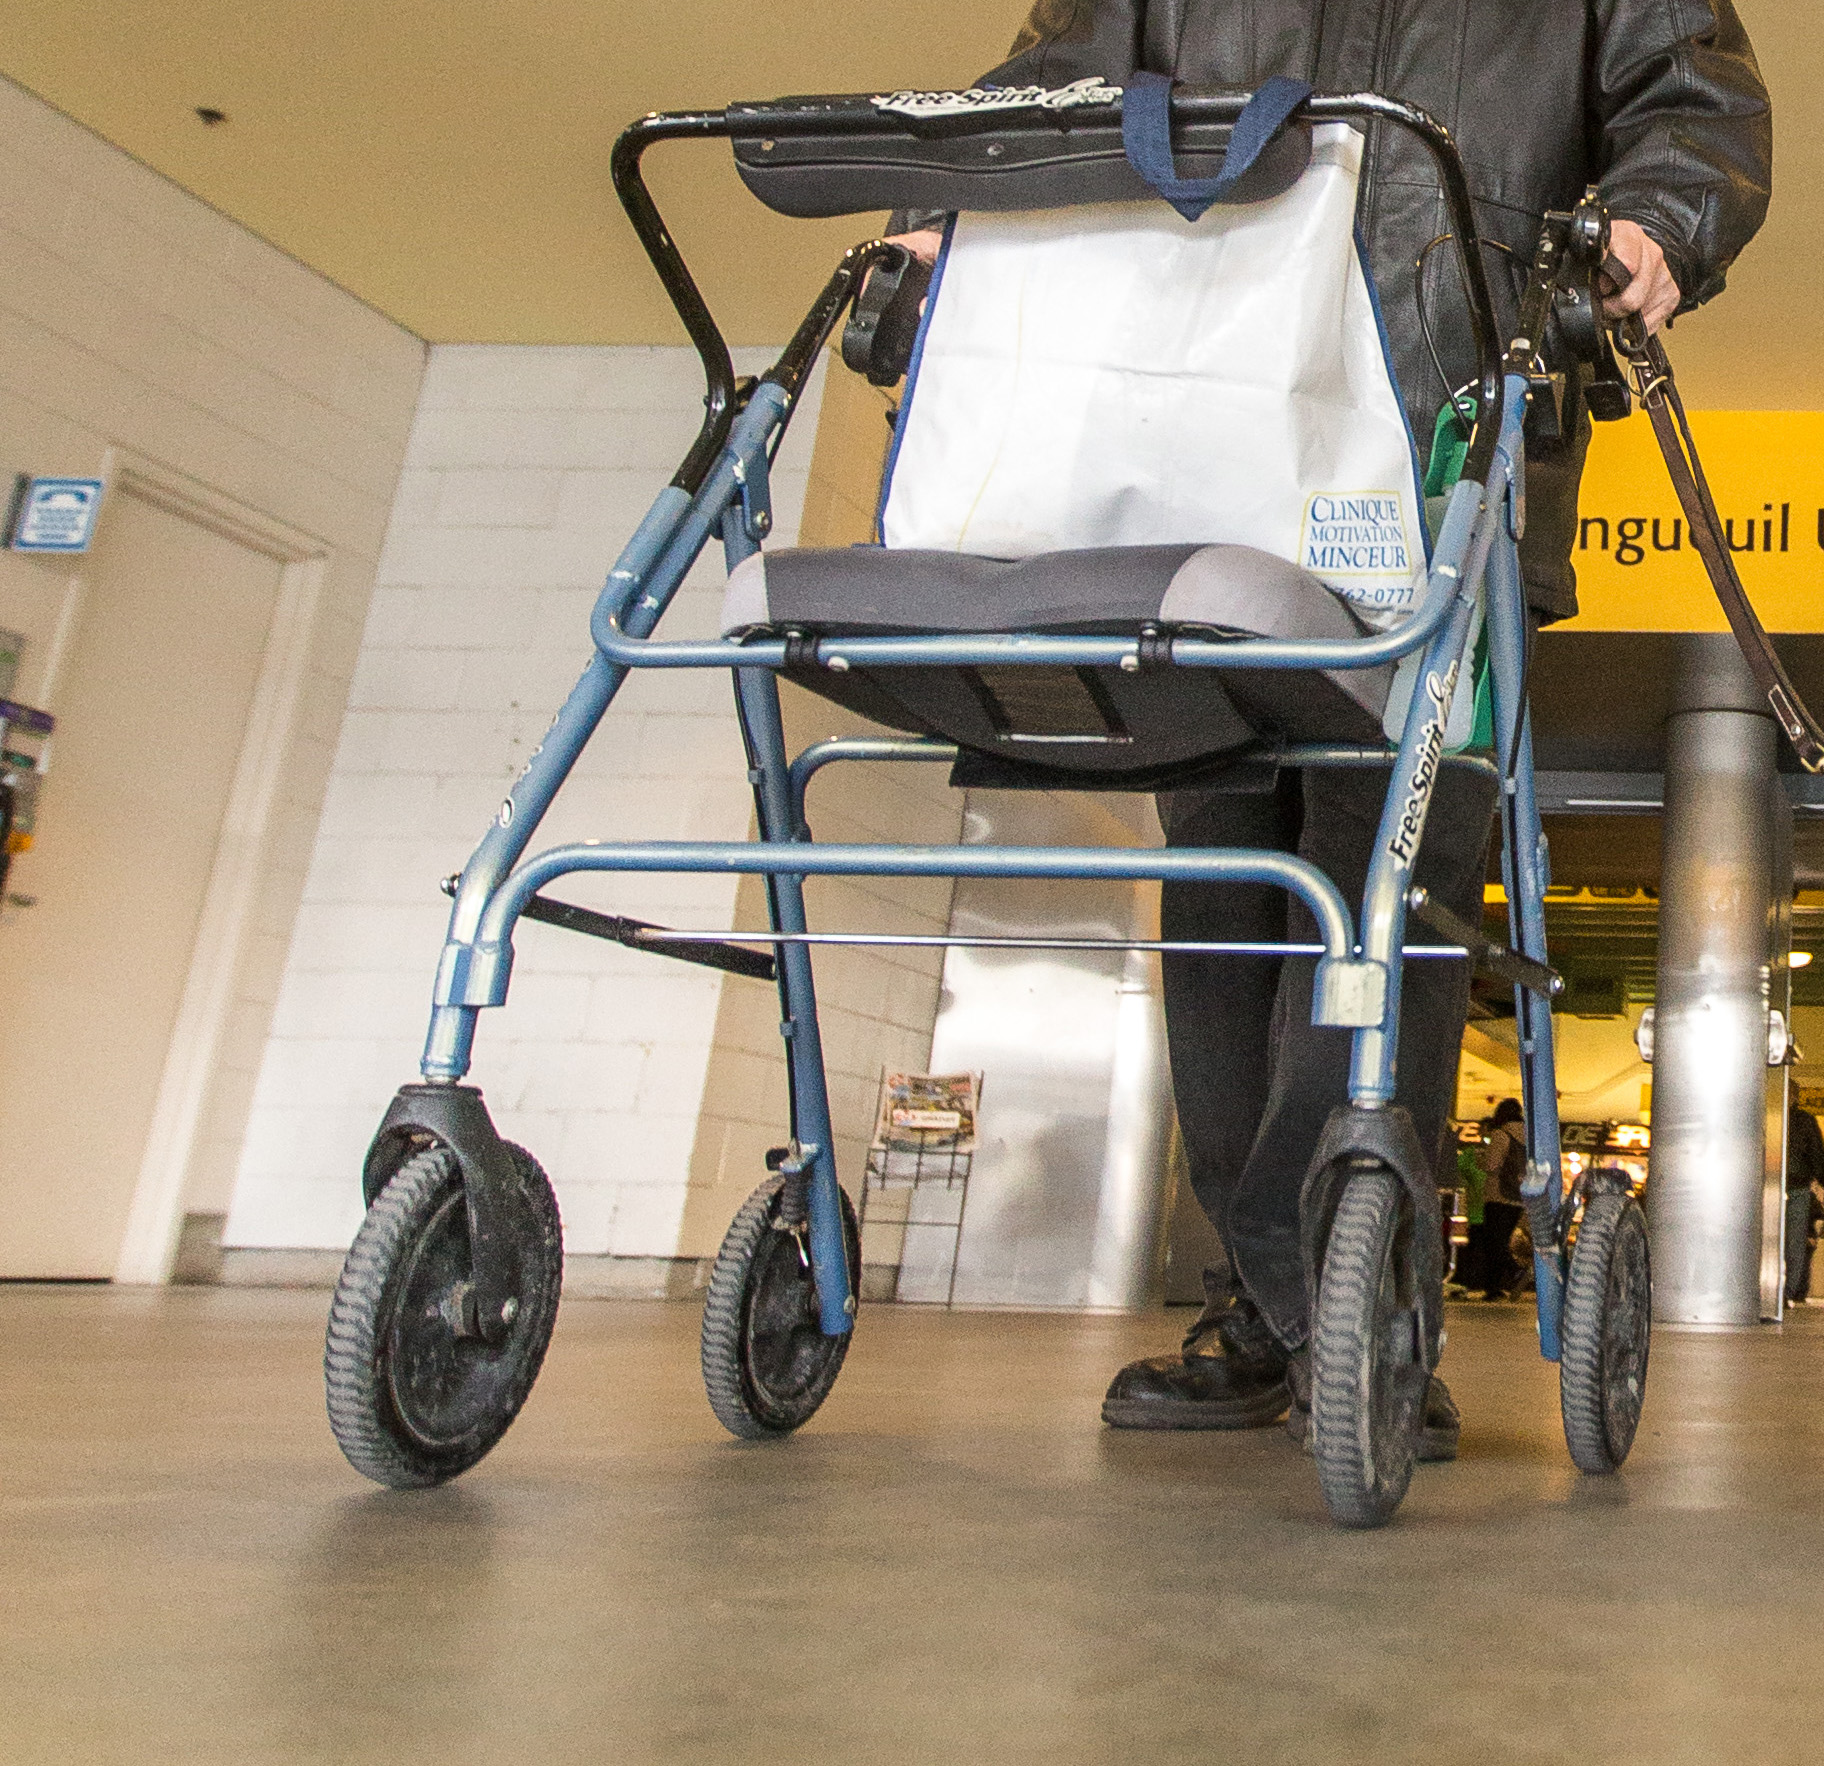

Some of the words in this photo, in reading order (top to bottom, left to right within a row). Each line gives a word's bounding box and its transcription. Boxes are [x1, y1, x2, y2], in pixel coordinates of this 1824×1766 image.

[886, 90, 954, 105] Free
[958, 86, 1043, 105] Spirit
[1310, 496, 1399, 525] CLINIQUE
[1310, 526, 1403, 542] MOTIVATION
[1580, 502, 1790, 566] nguuil
[1307, 546, 1407, 568] MINCEUR
[1389, 798, 1422, 863] Free
[1412, 723, 1443, 797] Spirit
